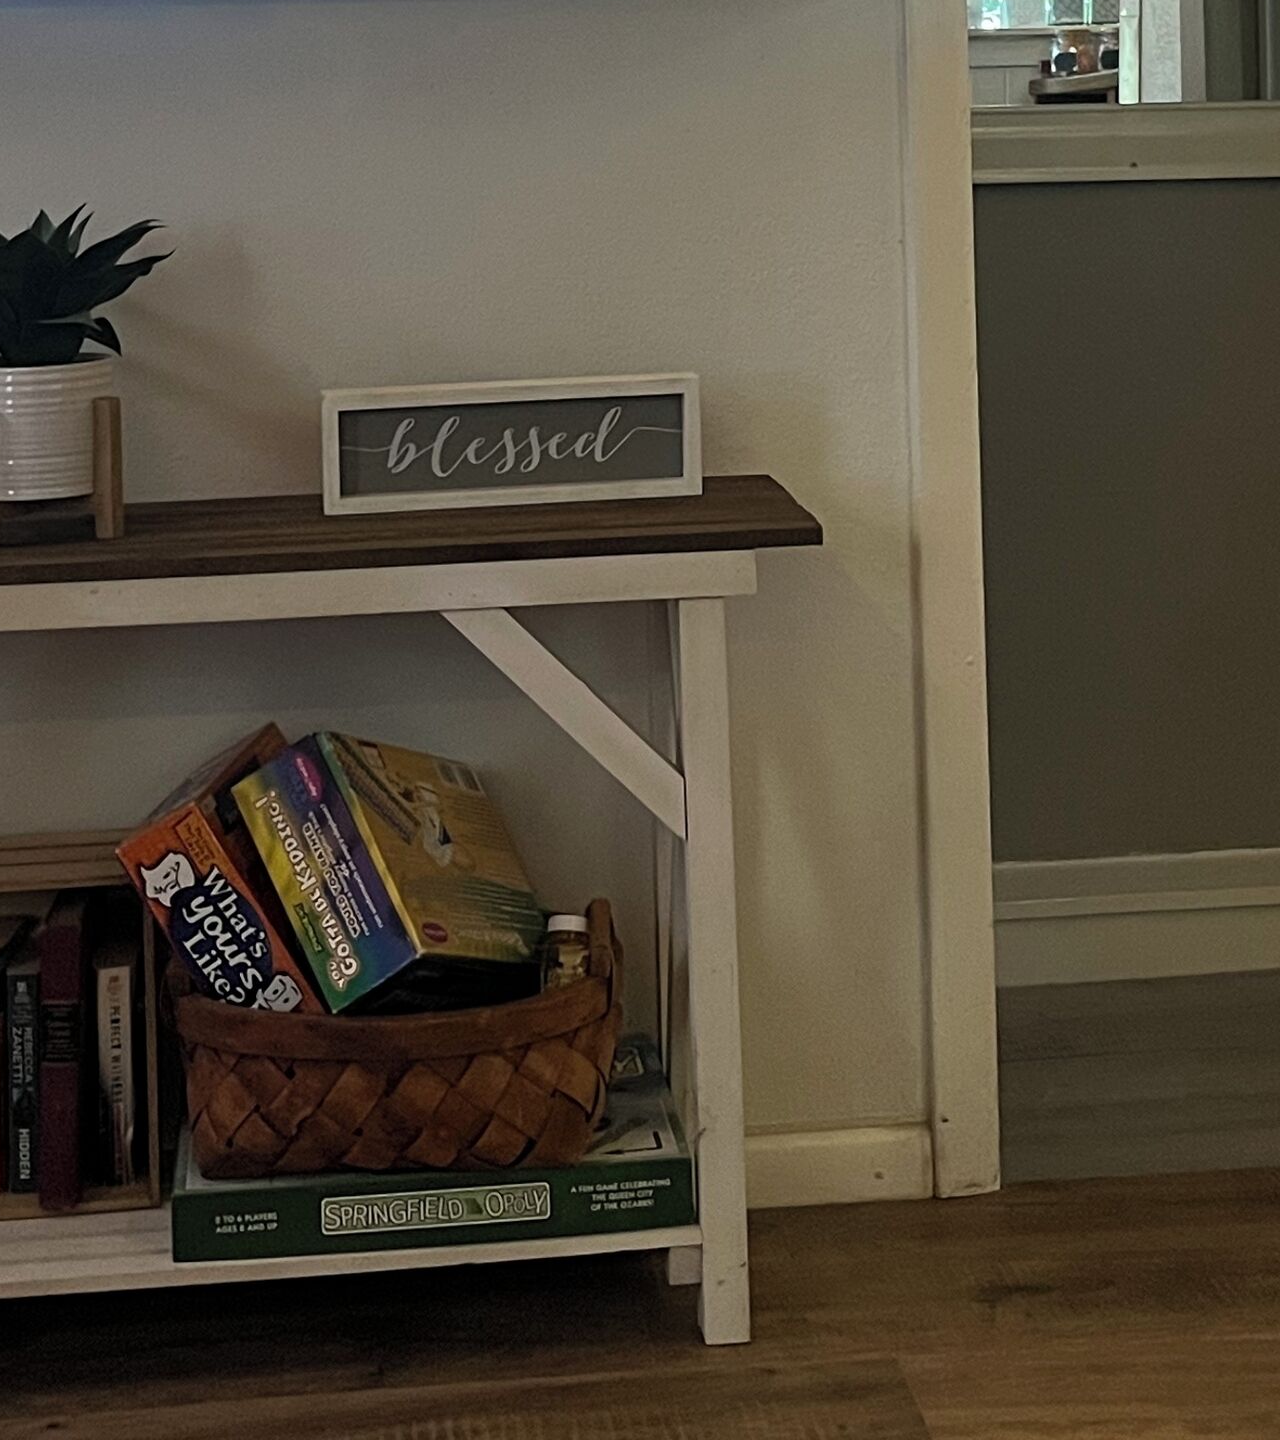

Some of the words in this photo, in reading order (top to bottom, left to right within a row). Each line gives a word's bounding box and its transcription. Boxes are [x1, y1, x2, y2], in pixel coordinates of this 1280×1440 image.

[341, 406, 682, 478] blessed
[255, 791, 317, 891] KIDDING!
[310, 888, 327, 912] BE
[323, 869, 341, 896] YOU
[203, 867, 267, 958] What's
[336, 895, 360, 938] WOULD
[182, 896, 263, 990] yours
[183, 930, 246, 1004] Like?
[321, 913, 357, 975] GOTTA
[329, 962, 345, 988] YOU
[24, 1027, 34, 1083] REBECCA
[19, 1128, 31, 1180] HIDDEN
[222, 1215, 235, 1223] TO
[324, 1196, 463, 1229] SPRINGFIELD
[484, 1189, 548, 1218] OPOLY
